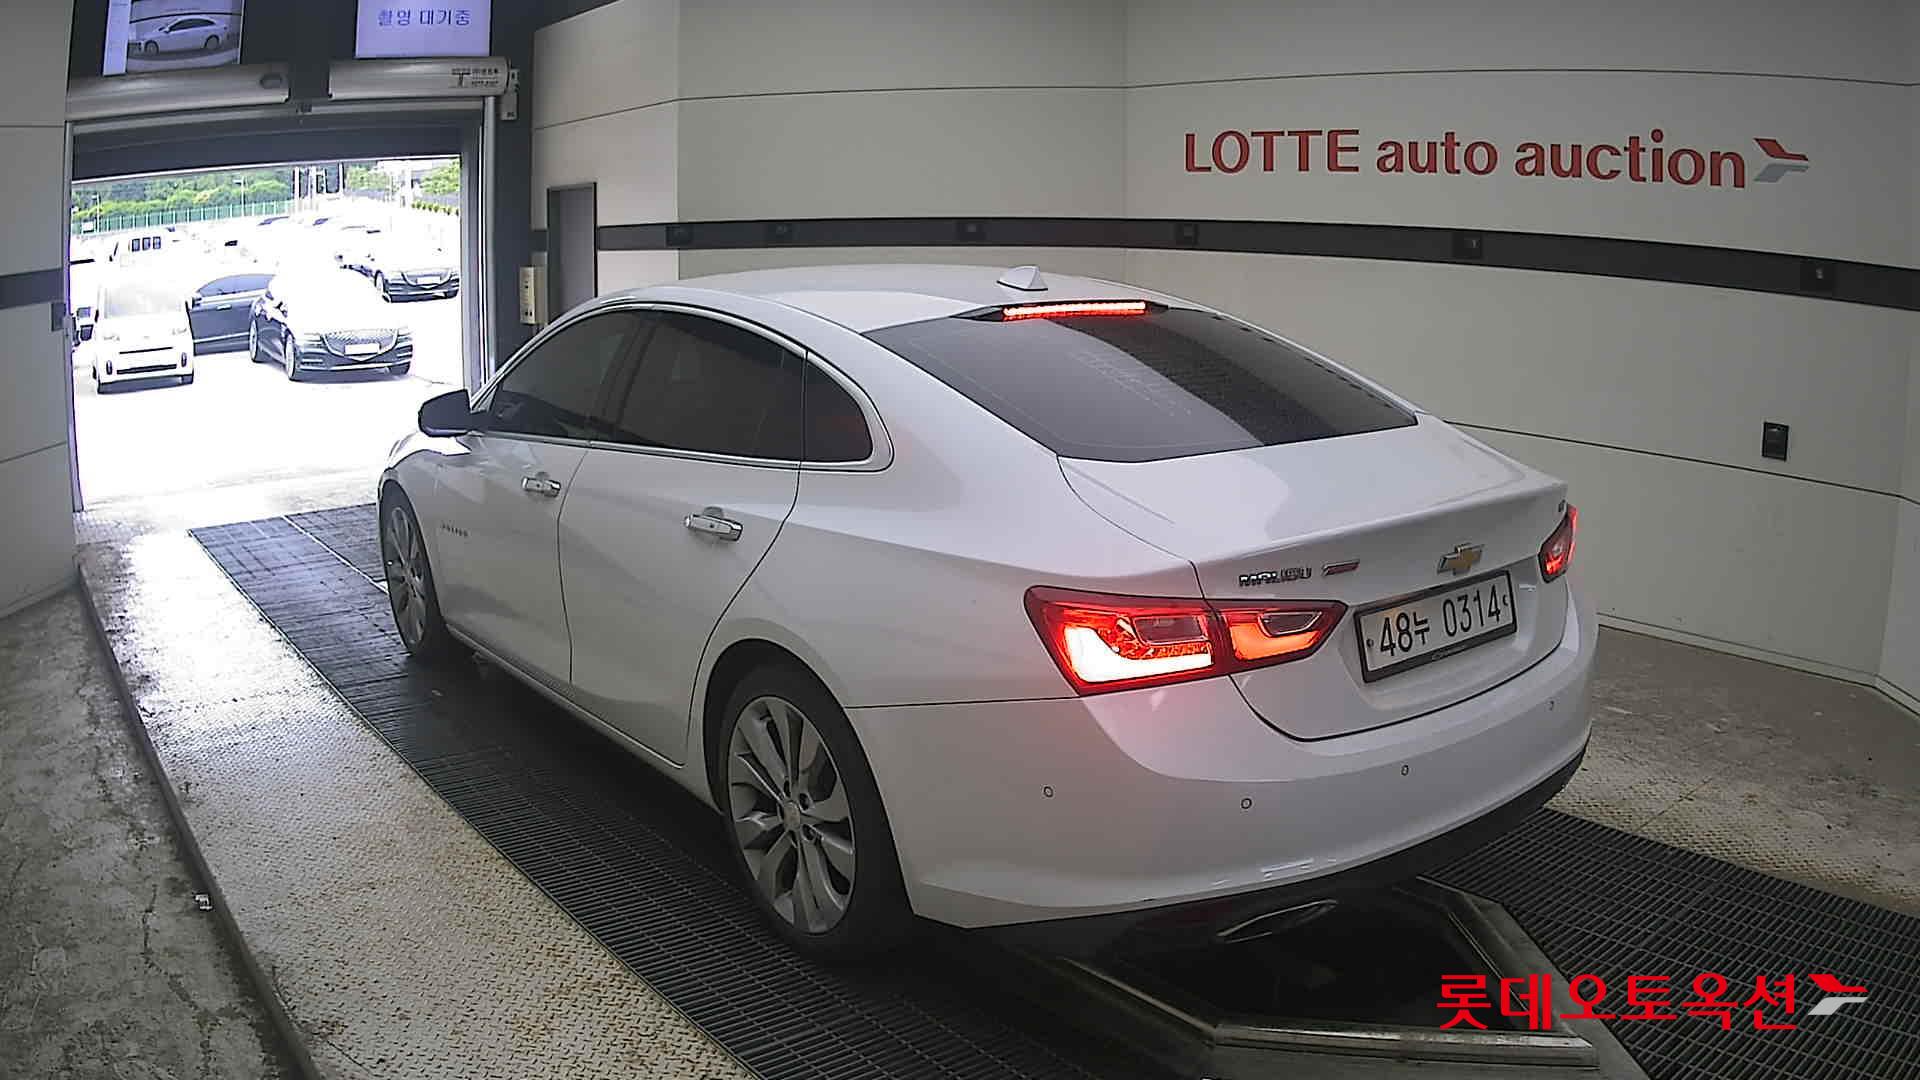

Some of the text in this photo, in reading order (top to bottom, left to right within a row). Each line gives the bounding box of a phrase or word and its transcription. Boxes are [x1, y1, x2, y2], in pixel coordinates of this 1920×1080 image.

[419, 8, 471, 26] 대기중
[1184, 128, 1745, 188] LOTTE auto auction
[1380, 584, 1501, 656] 48누 0314
